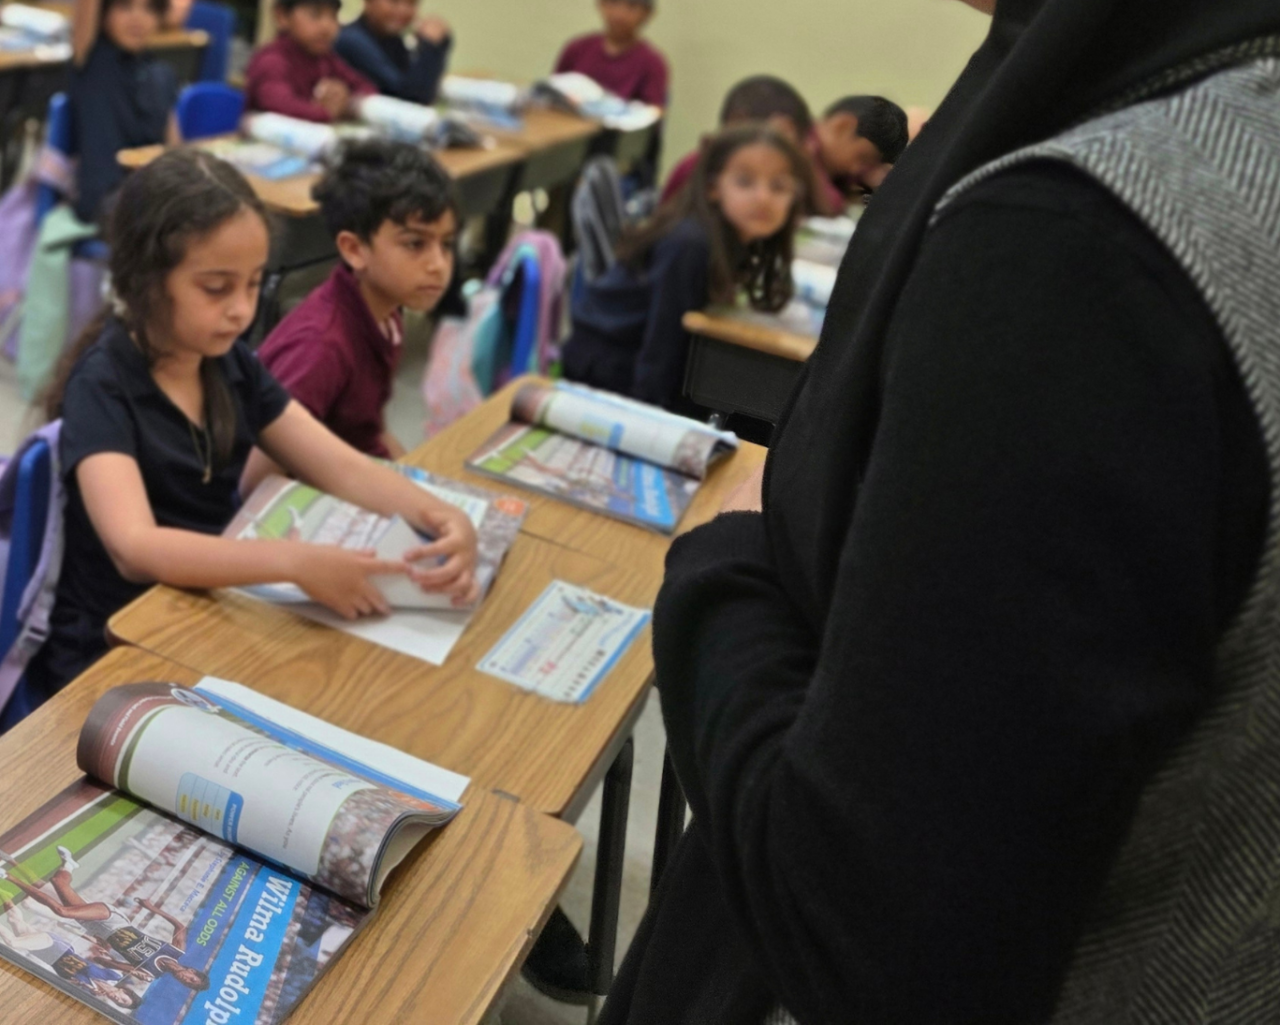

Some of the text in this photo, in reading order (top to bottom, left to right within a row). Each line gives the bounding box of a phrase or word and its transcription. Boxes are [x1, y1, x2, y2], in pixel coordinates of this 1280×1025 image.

[196, 860, 250, 947] AGAINST ALL ODDS
[204, 875, 293, 1025] Wilma Rudolp
